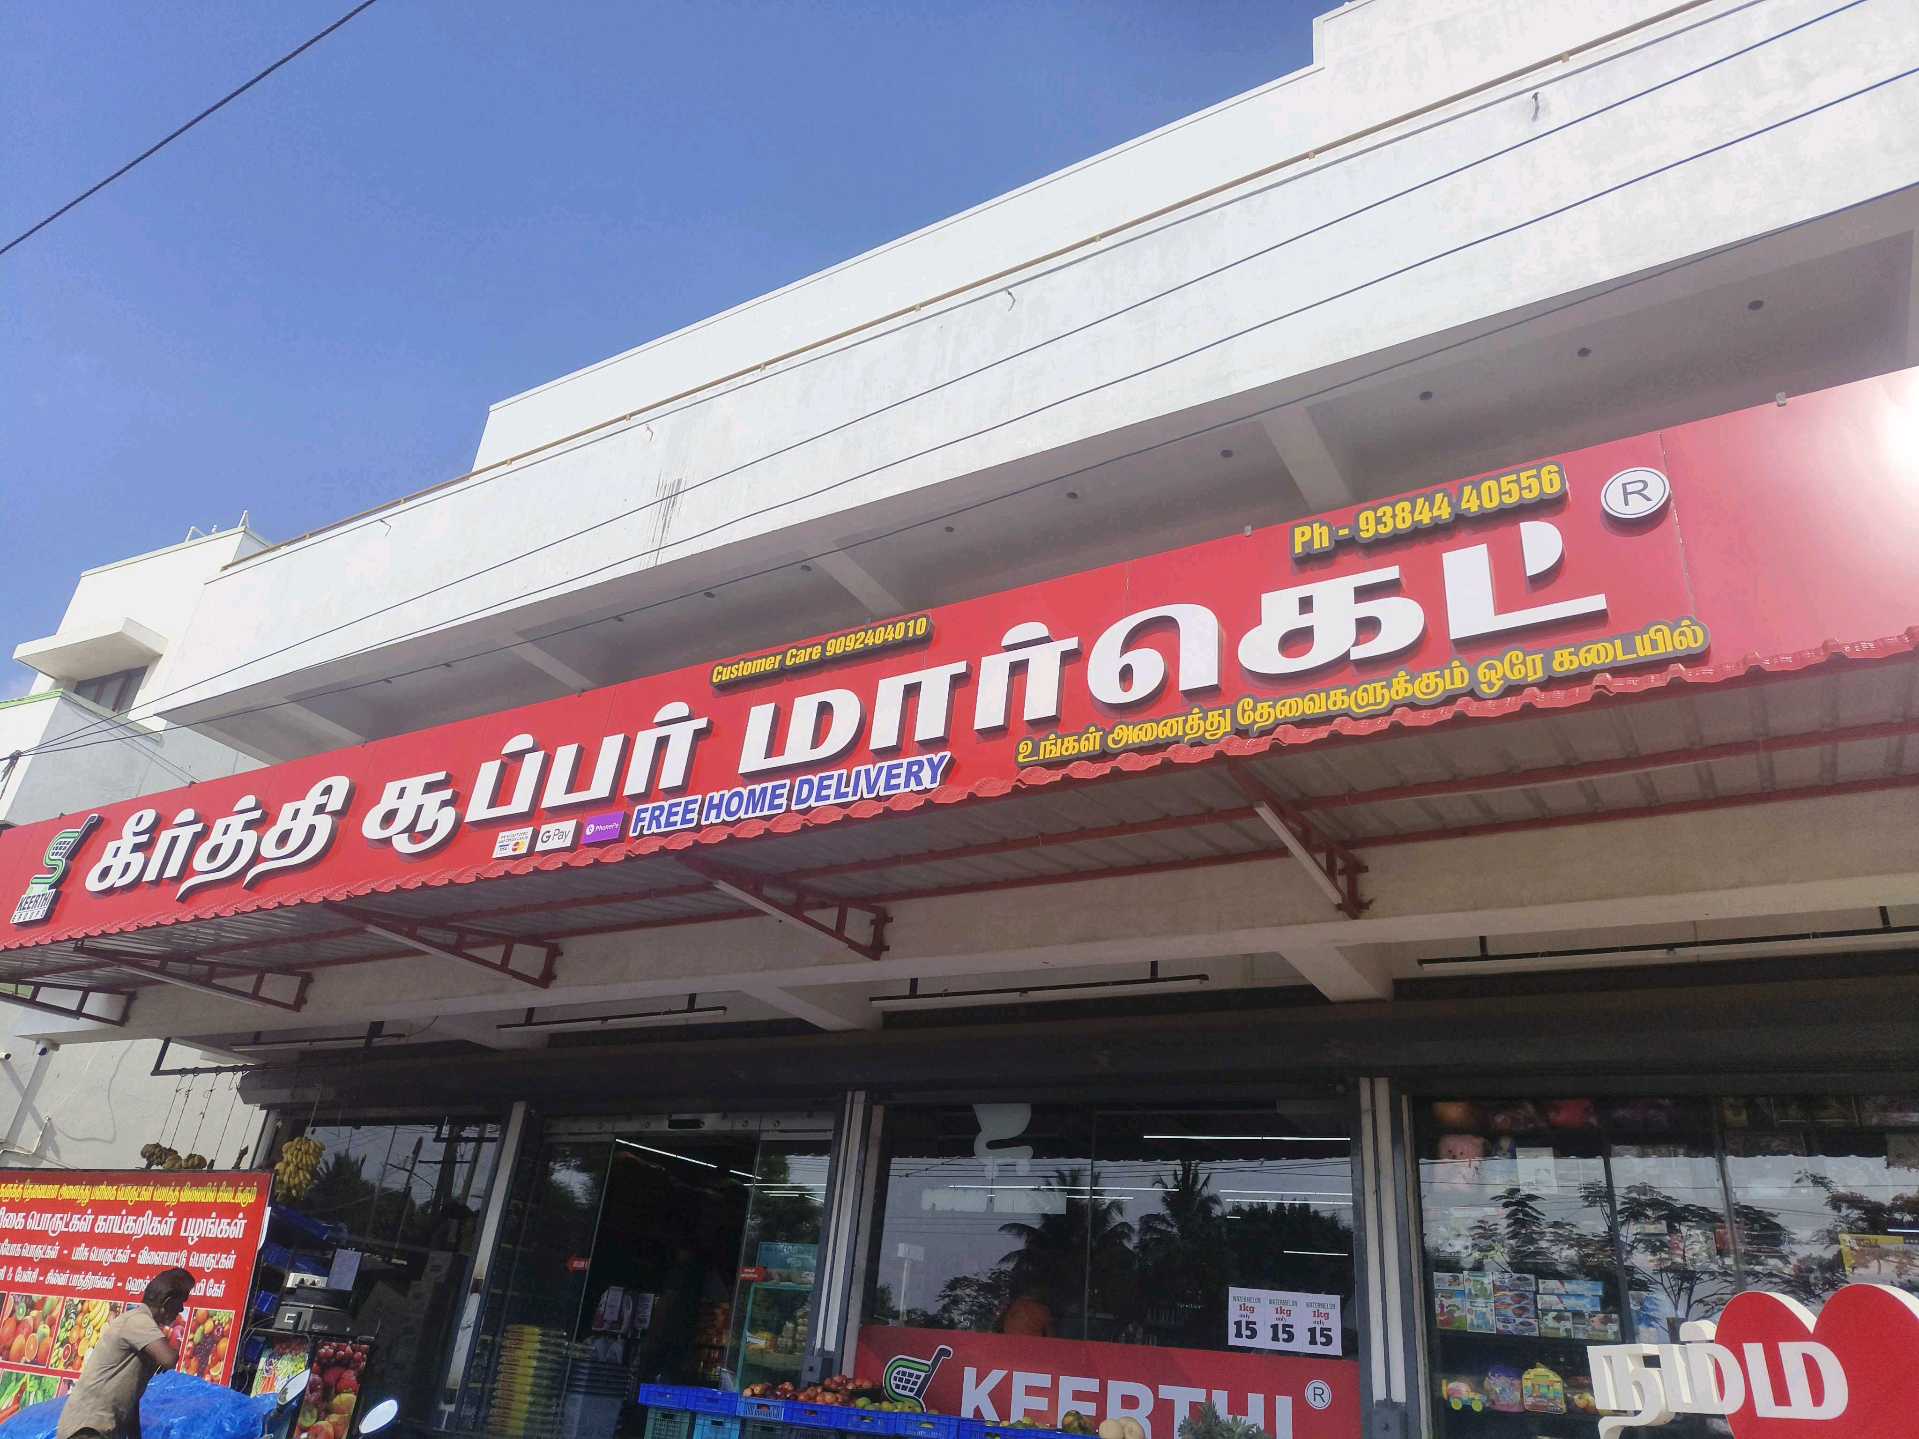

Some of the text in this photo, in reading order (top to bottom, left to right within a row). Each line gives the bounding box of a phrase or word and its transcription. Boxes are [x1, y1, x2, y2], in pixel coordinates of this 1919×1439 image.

[1294, 523, 1329, 554] Ph
[1359, 494, 1451, 539] 93844
[1460, 464, 1562, 513] 40556
[712, 617, 927, 684] Customer Care 9092404010
[1018, 620, 1704, 762] உங்கள் அனைத்து தேவைகளுக்கும் ஒரே கடையில்
[85, 521, 1607, 901] கீர்த்தி சூப்பர் மார்கெட்
[632, 753, 949, 836] FREE HOME DELIVERY
[27, 1209, 94, 1236] பொருட்கள்
[95, 1209, 177, 1240] காய்கறிகள்
[180, 1211, 247, 1245] பழங்கள்
[189, 1250, 236, 1272] பொருட்கள்
[1240, 1303, 1255, 1314] 1kg
[1275, 1306, 1291, 1317] 1kg
[1312, 1310, 1329, 1320] 1kg
[1234, 1320, 1257, 1339] 15
[1271, 1323, 1295, 1343] 15
[1308, 1327, 1333, 1346] 15
[1587, 1319, 1849, 1439] நம்ம
